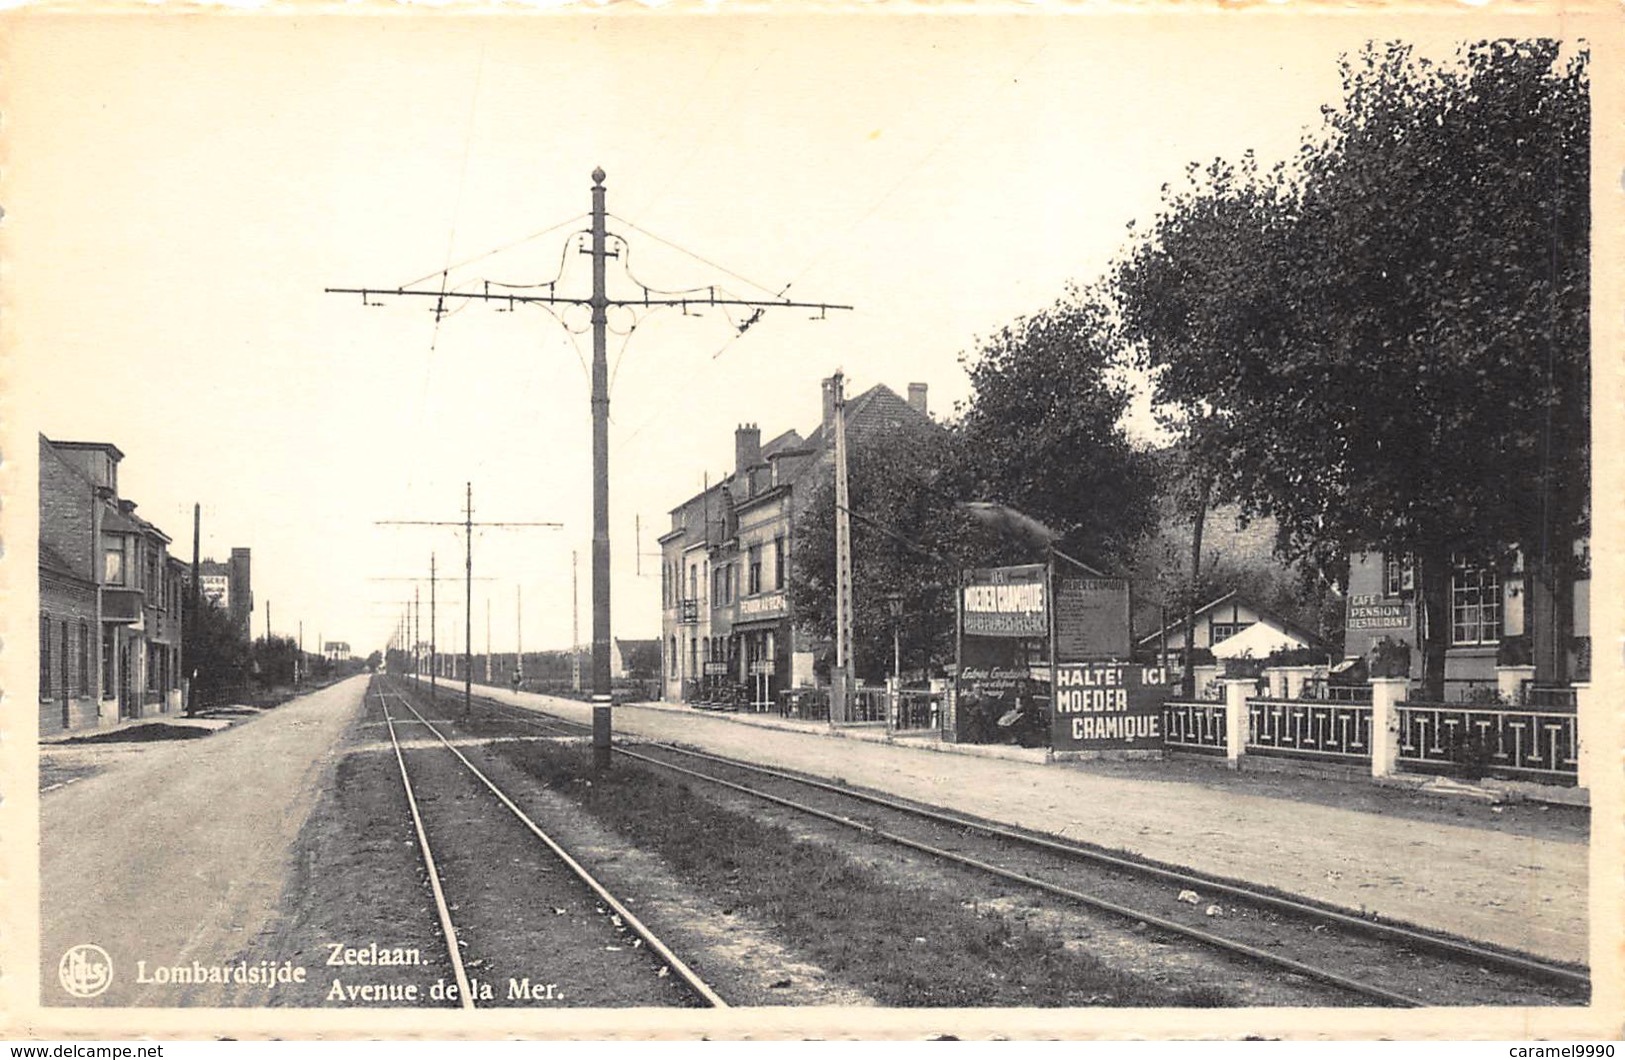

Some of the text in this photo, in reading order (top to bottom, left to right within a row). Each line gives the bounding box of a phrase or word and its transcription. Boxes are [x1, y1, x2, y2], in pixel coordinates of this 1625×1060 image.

[1351, 606, 1400, 617] PENSION
[1349, 616, 1408, 629] RESTAURANT
[1057, 668, 1166, 686] HALTE! ICI
[1057, 689, 1127, 713] MOEDER
[1072, 715, 1160, 742] CRAMIQUE
